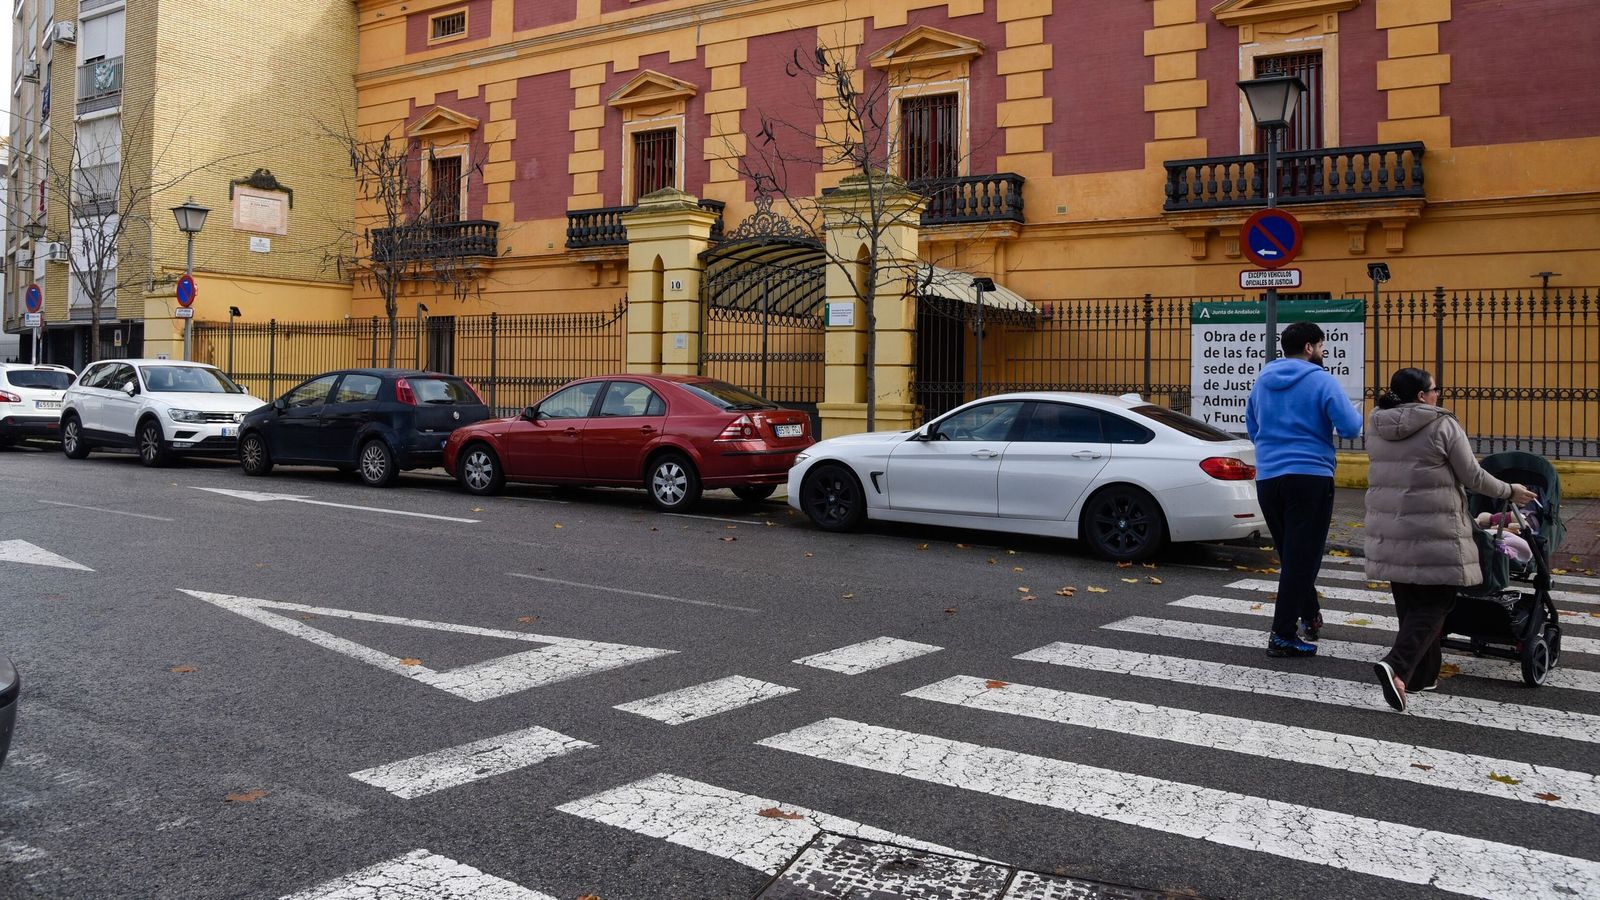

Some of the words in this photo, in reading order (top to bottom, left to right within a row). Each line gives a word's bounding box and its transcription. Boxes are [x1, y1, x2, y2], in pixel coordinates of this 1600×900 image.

[1248, 271, 1267, 279] EXCEPTO
[671, 280, 681, 290] 10
[1203, 330, 1236, 342] Obra
[1240, 330, 1256, 342] de
[1203, 346, 1220, 358] de
[1223, 346, 1242, 358] las
[1333, 346, 1346, 358] la
[1203, 362, 1235, 374] sede
[1238, 362, 1255, 374] de
[1203, 378, 1220, 390] de
[1203, 413, 1211, 424] y
[1214, 411, 1246, 423] Func
